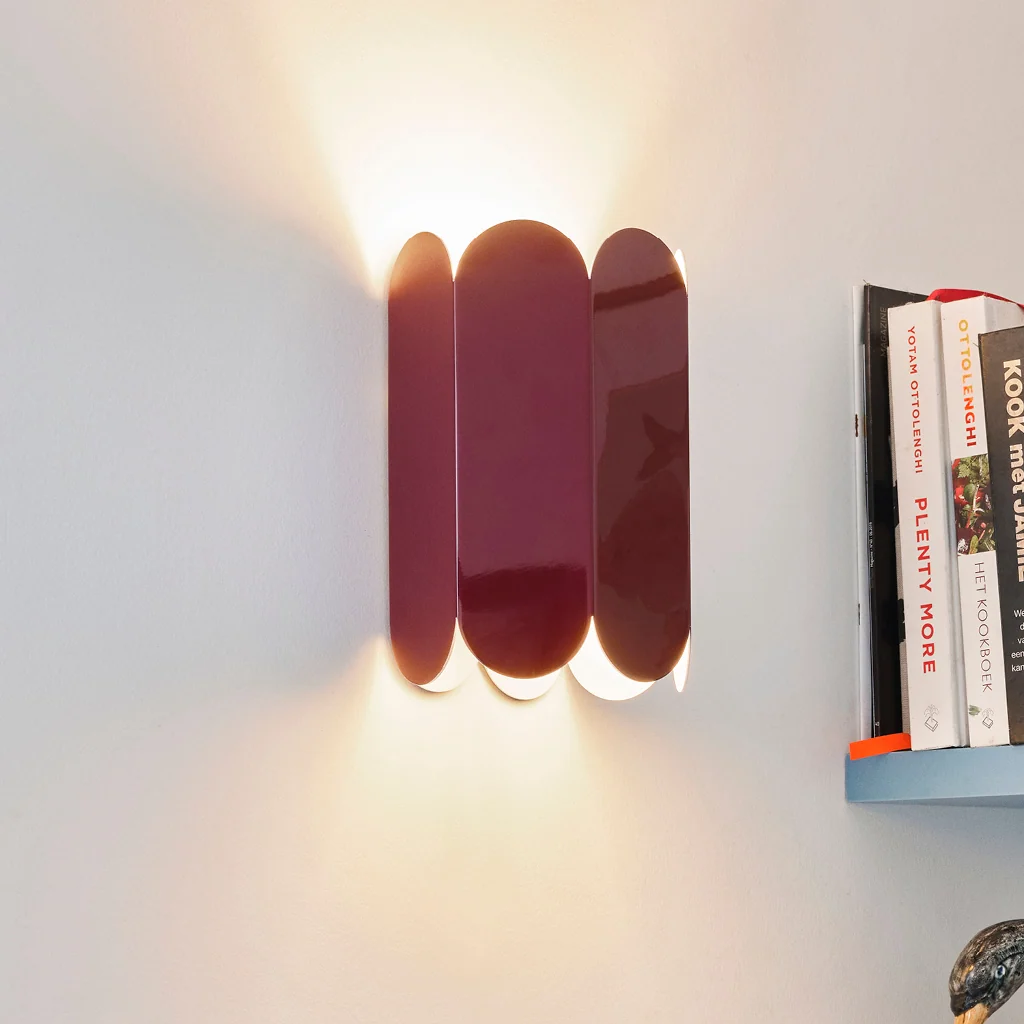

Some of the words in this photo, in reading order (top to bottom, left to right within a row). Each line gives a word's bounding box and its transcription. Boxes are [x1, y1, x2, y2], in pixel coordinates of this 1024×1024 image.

[908, 326, 917, 374] YOTAM
[959, 320, 976, 447] OTTOLENGHI
[910, 381, 922, 474] OTTOLENGHI
[915, 498, 932, 592] PLENTY
[974, 562, 986, 593] HET
[920, 604, 936, 674] MORE
[977, 599, 992, 693] KOOKBOEK
[1012, 664, 1024, 672] kan
